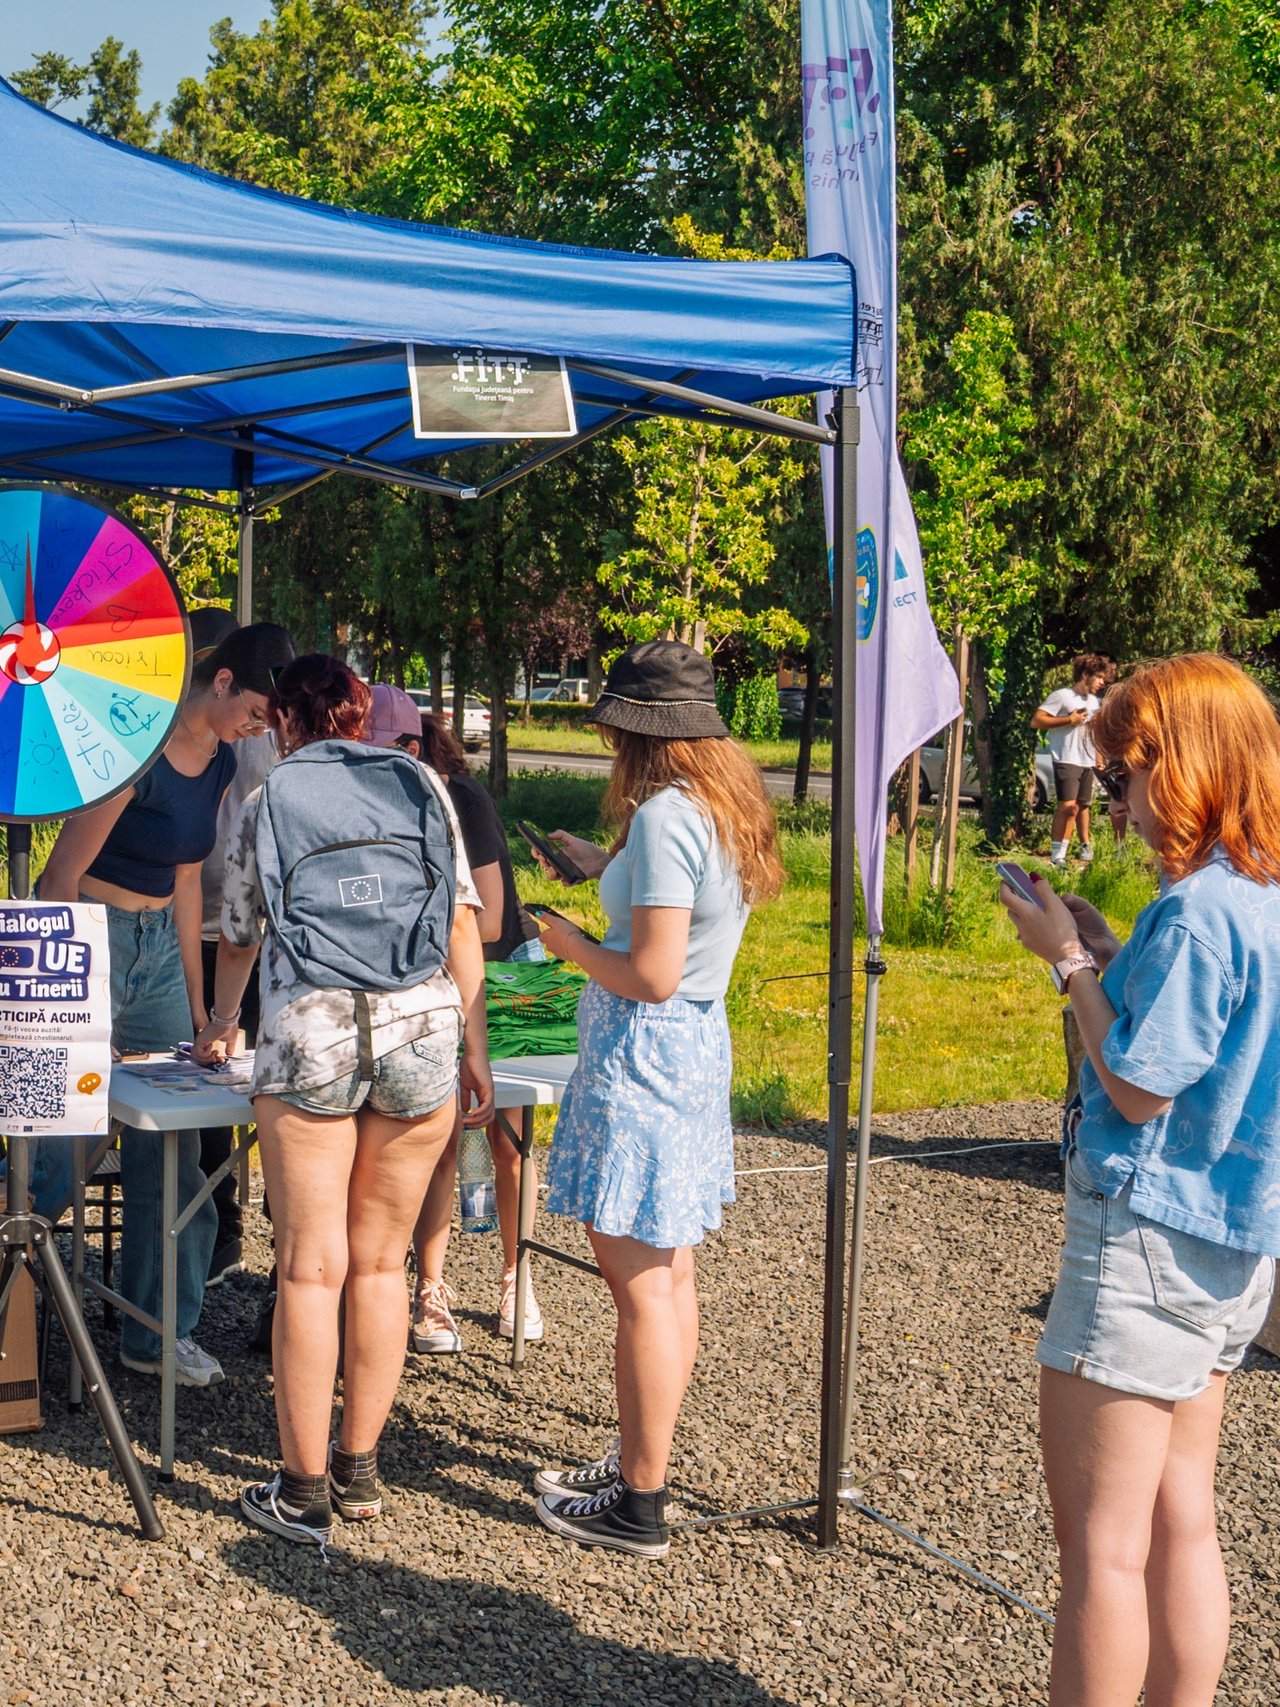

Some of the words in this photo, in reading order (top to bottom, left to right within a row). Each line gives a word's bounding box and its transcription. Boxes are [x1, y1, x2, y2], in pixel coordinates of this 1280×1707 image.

[88, 648, 173, 678] Tricou
[44, 940, 86, 974] UE
[14, 978, 84, 998] Tinerii
[50, 1011, 91, 1024] ACUM!
